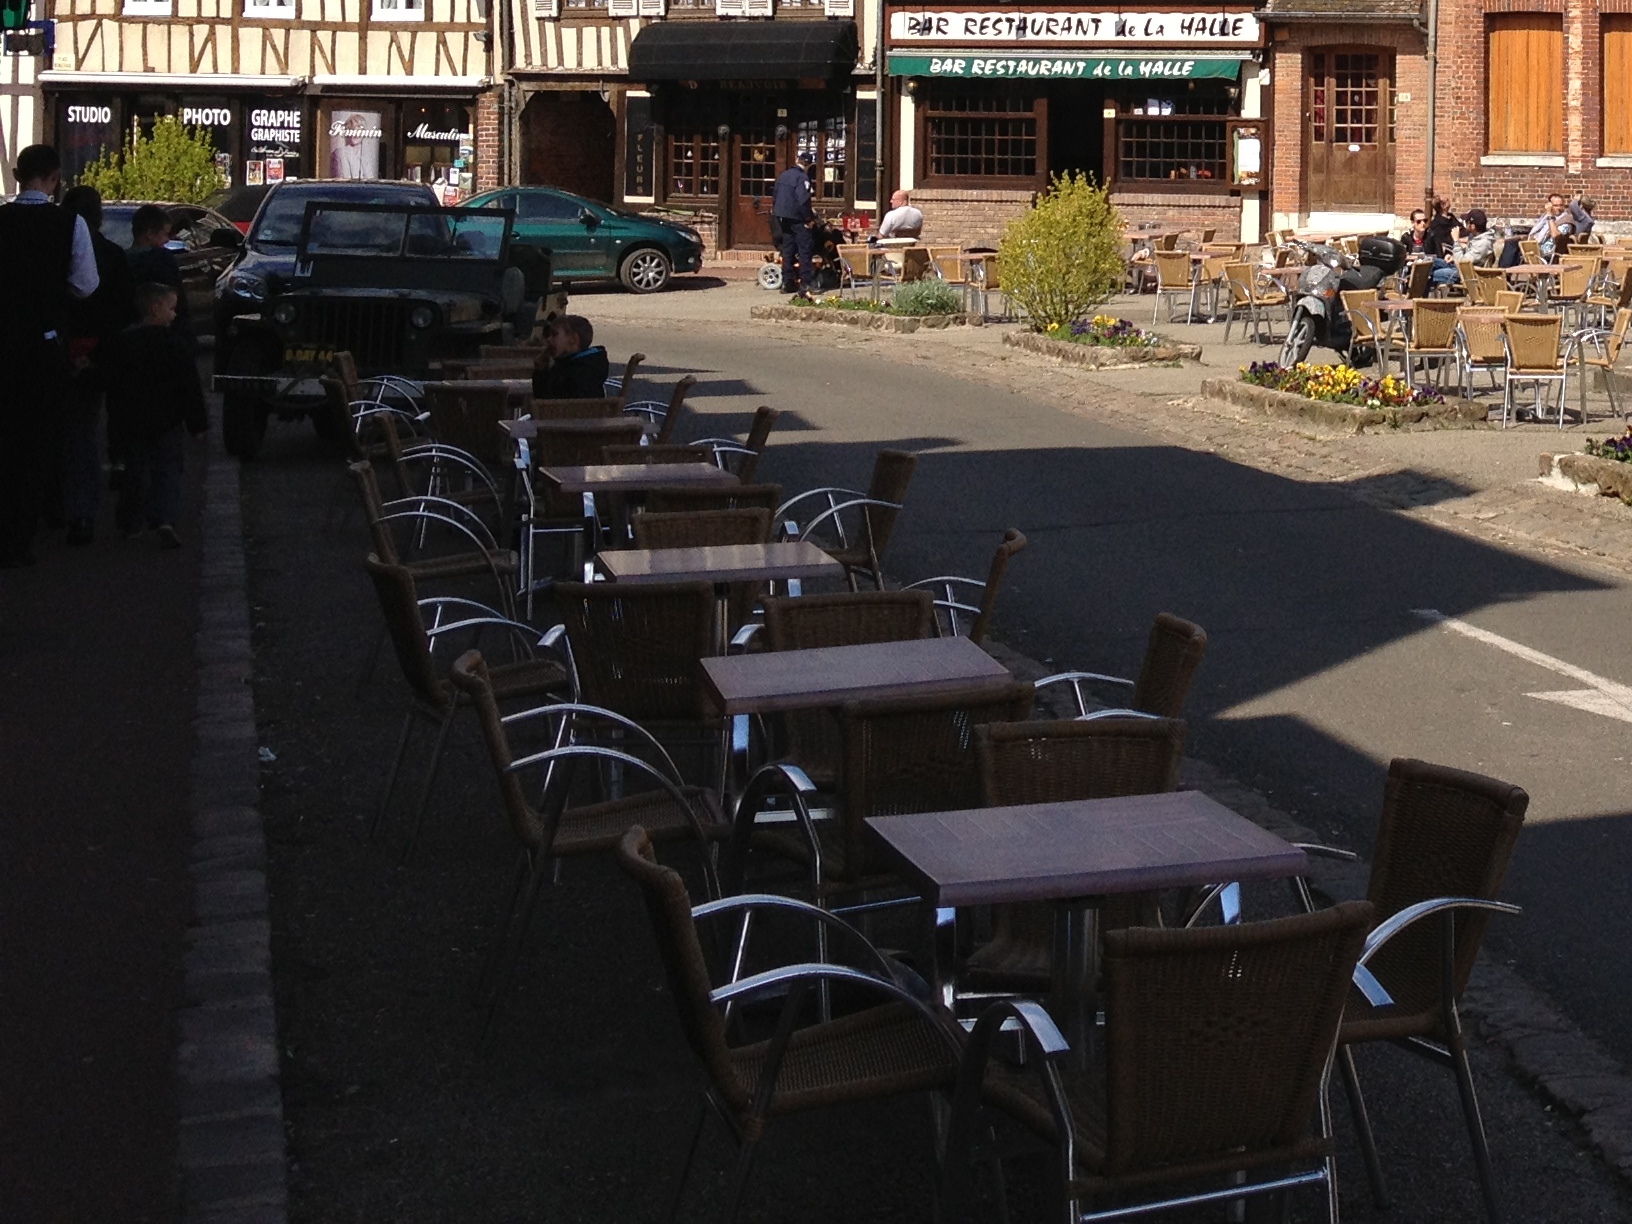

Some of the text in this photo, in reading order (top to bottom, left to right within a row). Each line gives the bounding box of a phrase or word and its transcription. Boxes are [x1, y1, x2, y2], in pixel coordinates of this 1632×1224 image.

[907, 16, 949, 36] BAR
[963, 16, 1103, 37] RESTAURANT
[1117, 18, 1137, 37] de
[1180, 16, 1244, 37] HALLE
[929, 58, 1195, 78] BAR RESTAURANT de la HALLE
[67, 105, 111, 123] STUDIO
[183, 108, 231, 126] PHOTO
[251, 109, 301, 128] GRAPHE
[250, 128, 301, 143] GRAPHISTE
[636, 133, 645, 194] FLEURS
